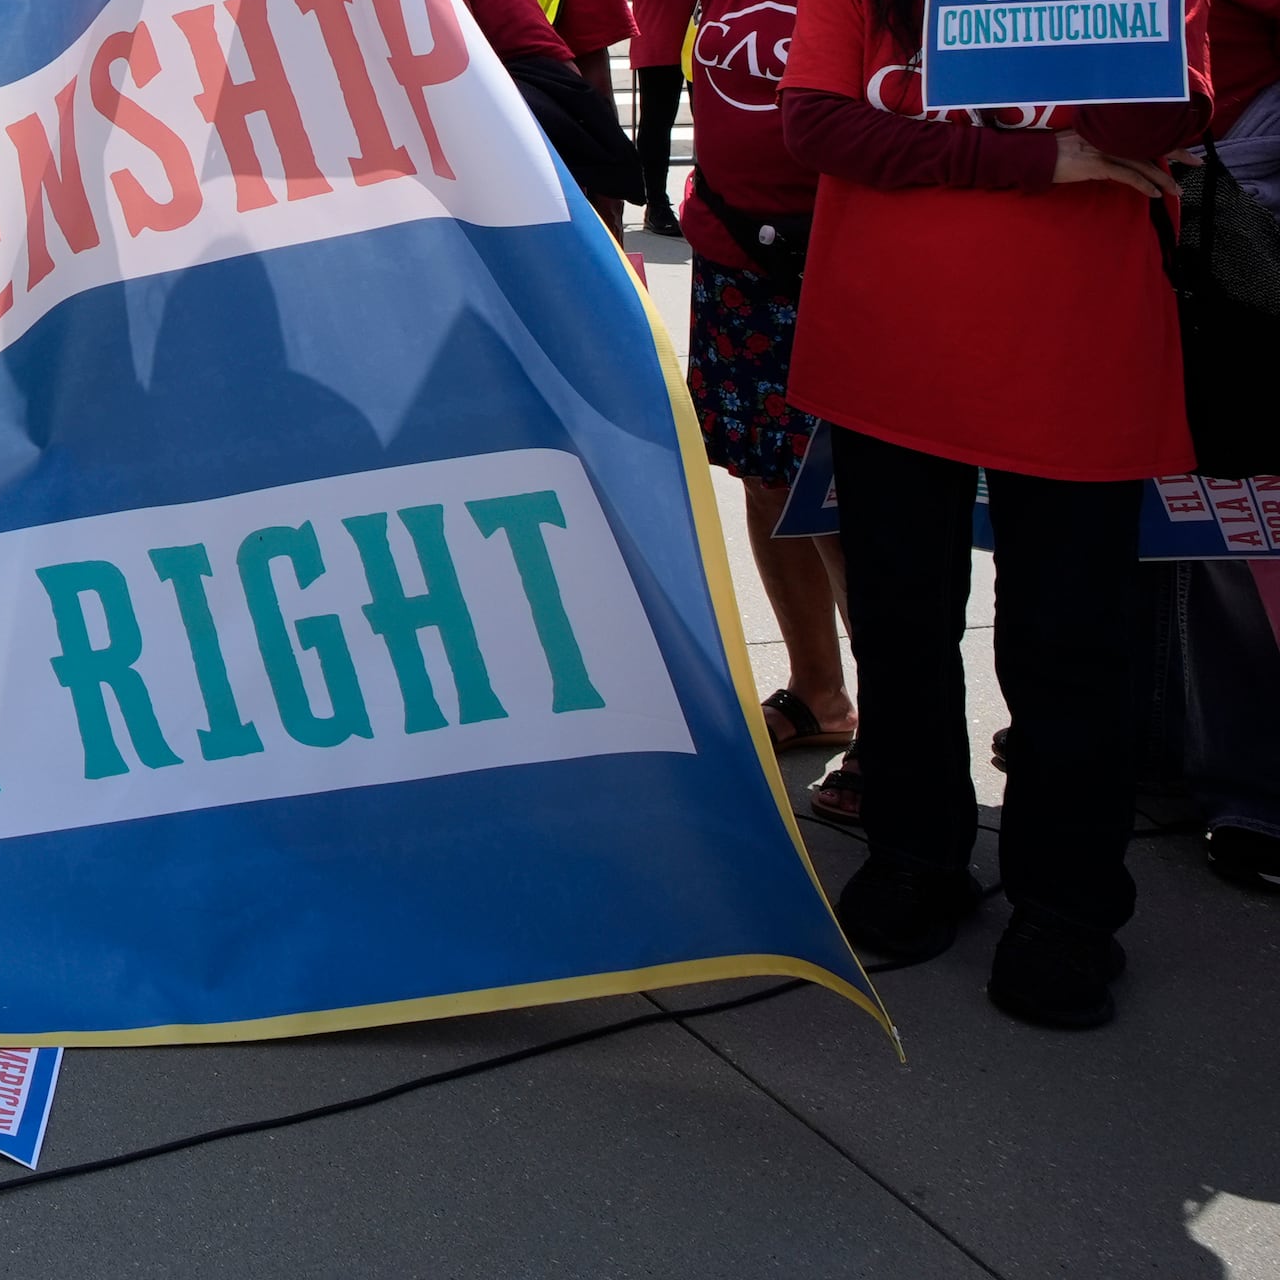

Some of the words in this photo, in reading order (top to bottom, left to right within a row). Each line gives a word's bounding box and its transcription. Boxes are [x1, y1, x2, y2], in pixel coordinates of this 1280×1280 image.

[943, 2, 1162, 46] CONSTITUCIONAL
[1165, 490, 1206, 513] EL
[1215, 496, 1257, 523] LA
[1227, 530, 1263, 546] A
[36, 488, 605, 780] RIGHT
